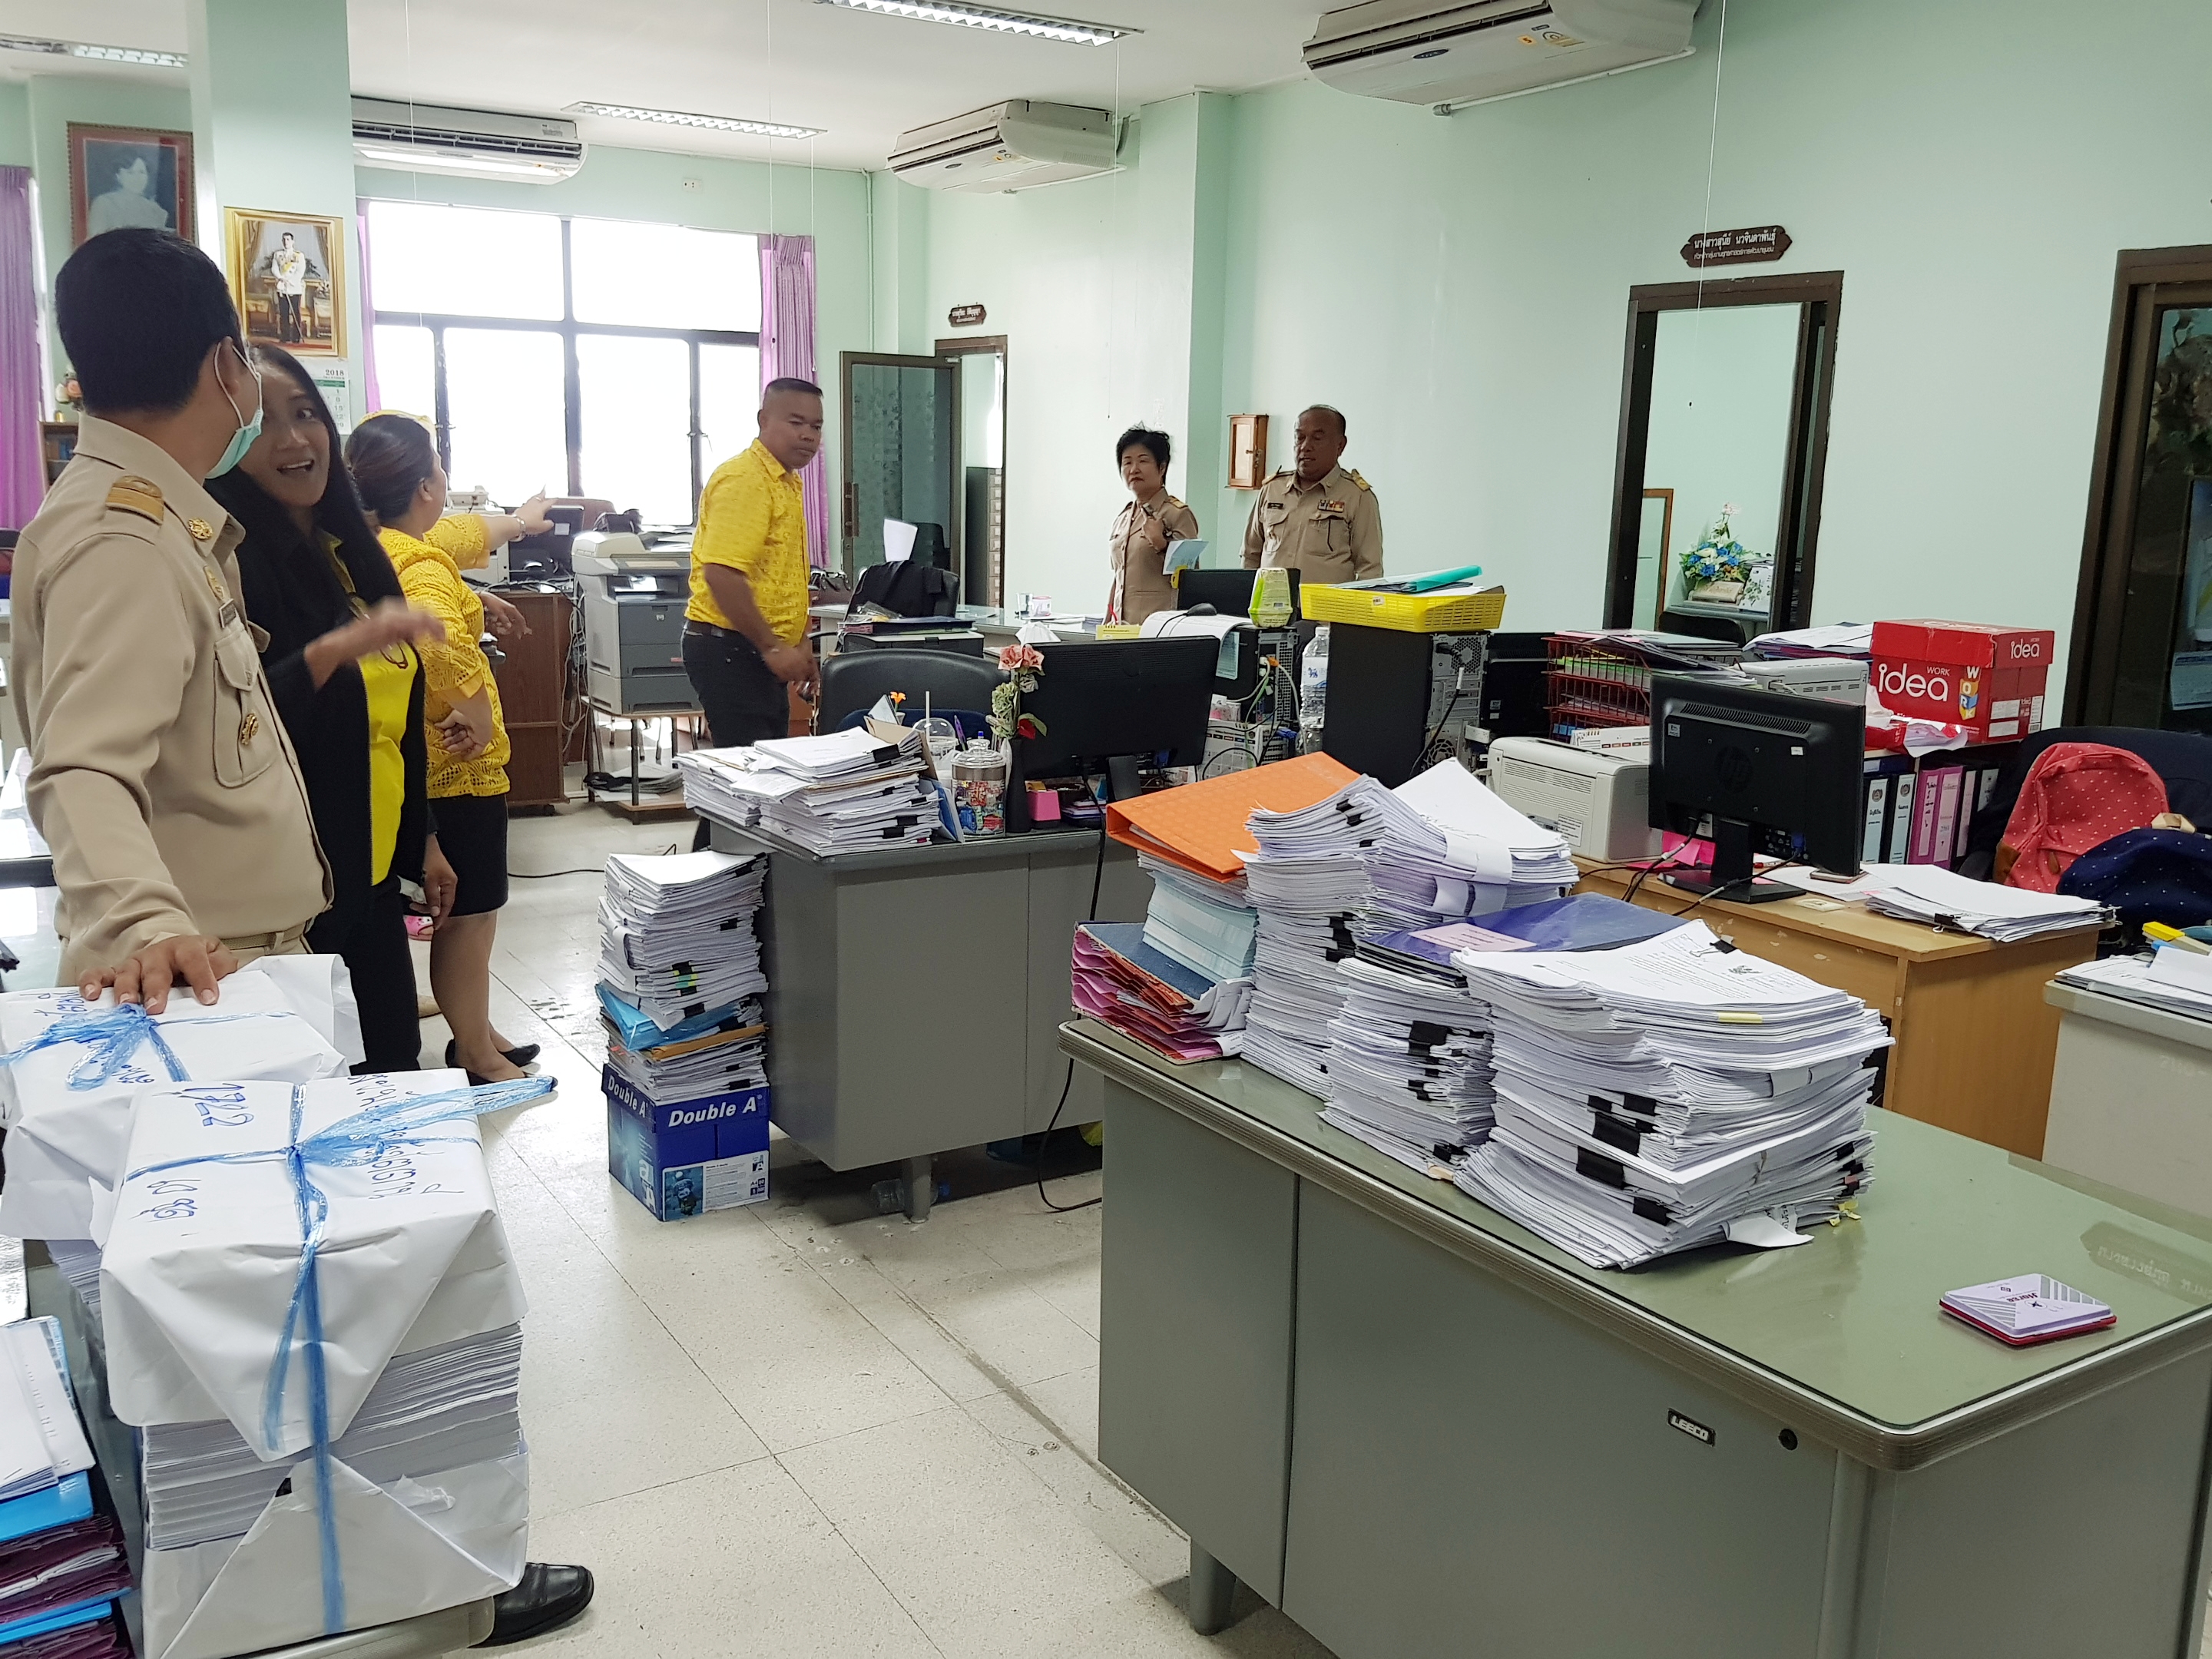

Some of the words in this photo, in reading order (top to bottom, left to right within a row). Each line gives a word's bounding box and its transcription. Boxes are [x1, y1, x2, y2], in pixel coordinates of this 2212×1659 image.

[2010, 638, 2040, 660] idea
[1878, 663, 1949, 702] idea
[1926, 666, 1951, 677] WORK
[608, 1075, 637, 1111] Double
[639, 1101, 647, 1118] A
[668, 1101, 737, 1128] Double
[1671, 1416, 1709, 1441] LEECO
